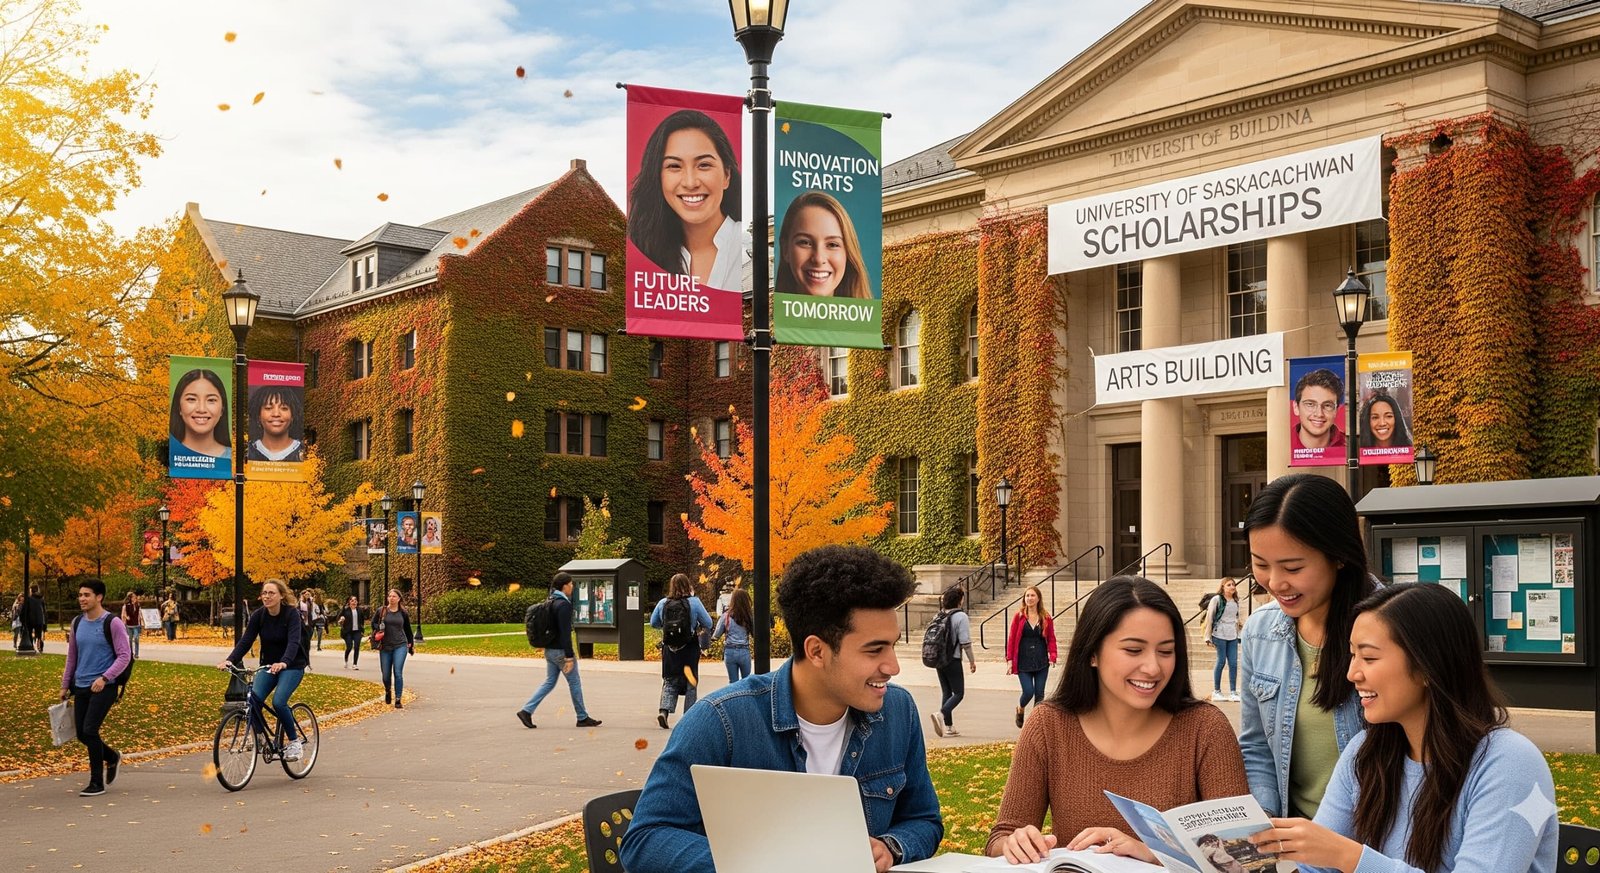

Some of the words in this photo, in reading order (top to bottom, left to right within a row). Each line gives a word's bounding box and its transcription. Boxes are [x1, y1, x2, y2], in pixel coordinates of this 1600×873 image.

[779, 149, 879, 176] INNOVATION
[792, 170, 853, 193] STARTS
[1076, 190, 1172, 225] UNIVERSITY
[1176, 185, 1198, 206] OF
[1203, 153, 1354, 200] SASKACACHWAN
[1083, 186, 1322, 259] SCHOLARSHIPS
[634, 271, 701, 293] FUTURE
[634, 291, 710, 313] LEADERS
[782, 300, 874, 322] TOMORROW
[1106, 362, 1158, 391] ARTS
[1165, 348, 1272, 384] BUILDING
